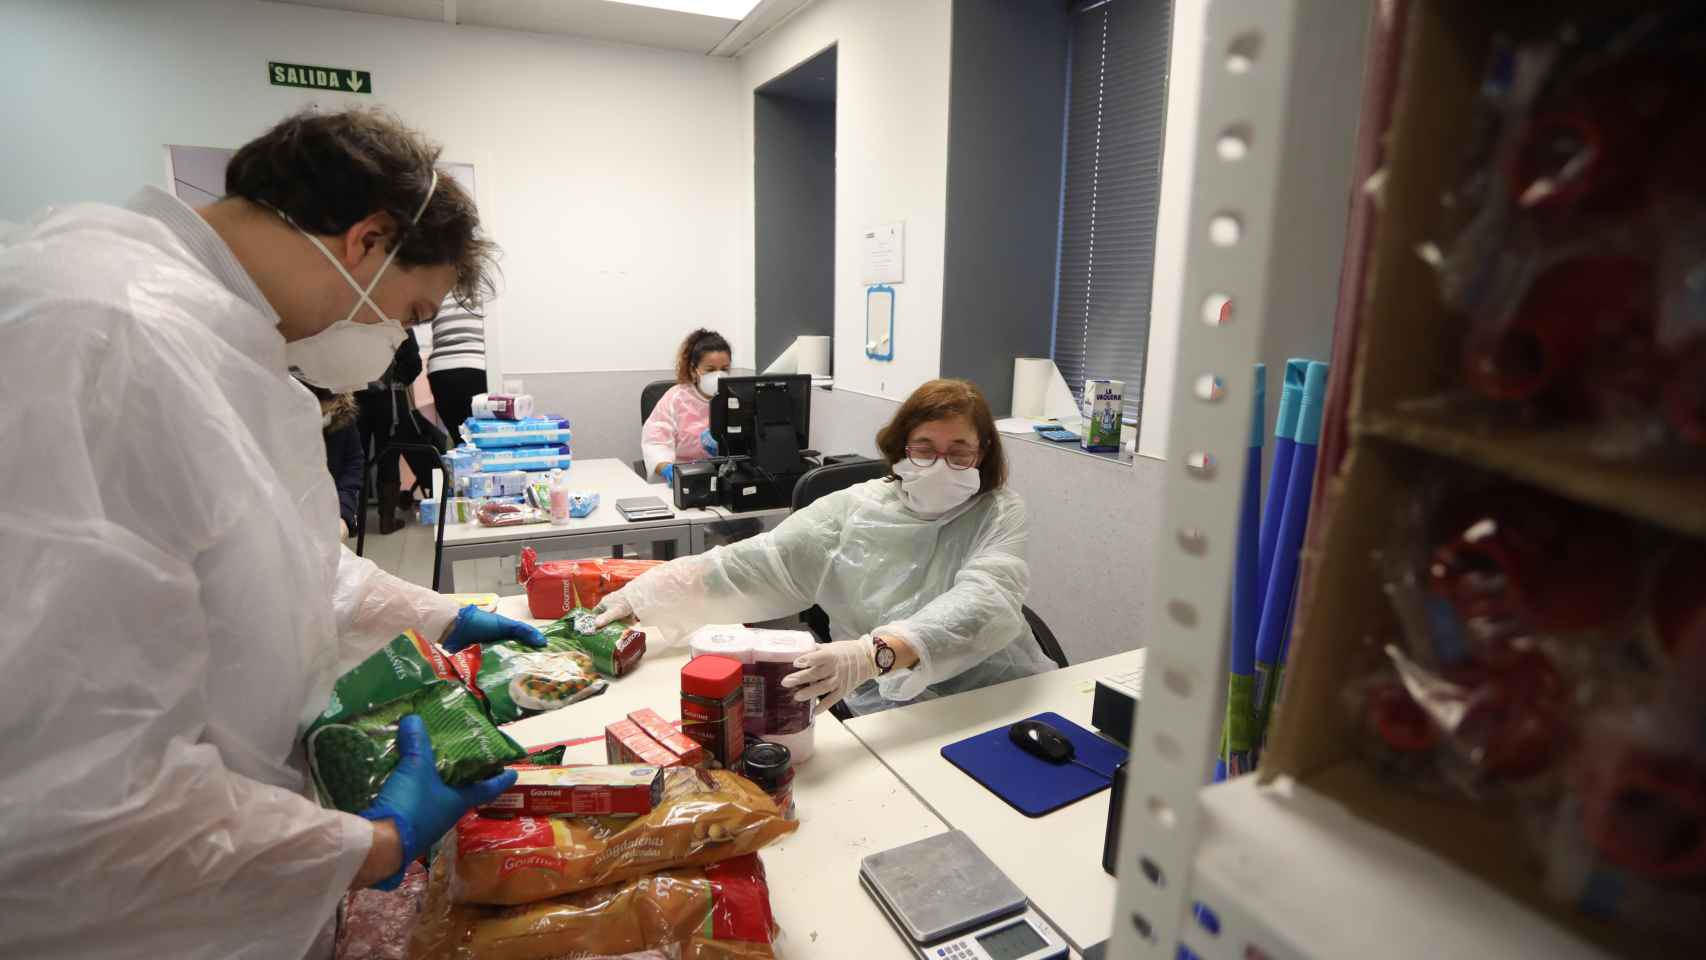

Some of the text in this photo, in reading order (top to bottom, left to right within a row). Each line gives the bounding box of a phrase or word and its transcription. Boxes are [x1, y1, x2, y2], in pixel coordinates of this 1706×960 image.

[274, 66, 340, 88] SALIDA
[562, 577, 570, 612] Gourmet
[530, 788, 561, 797] Gourmet
